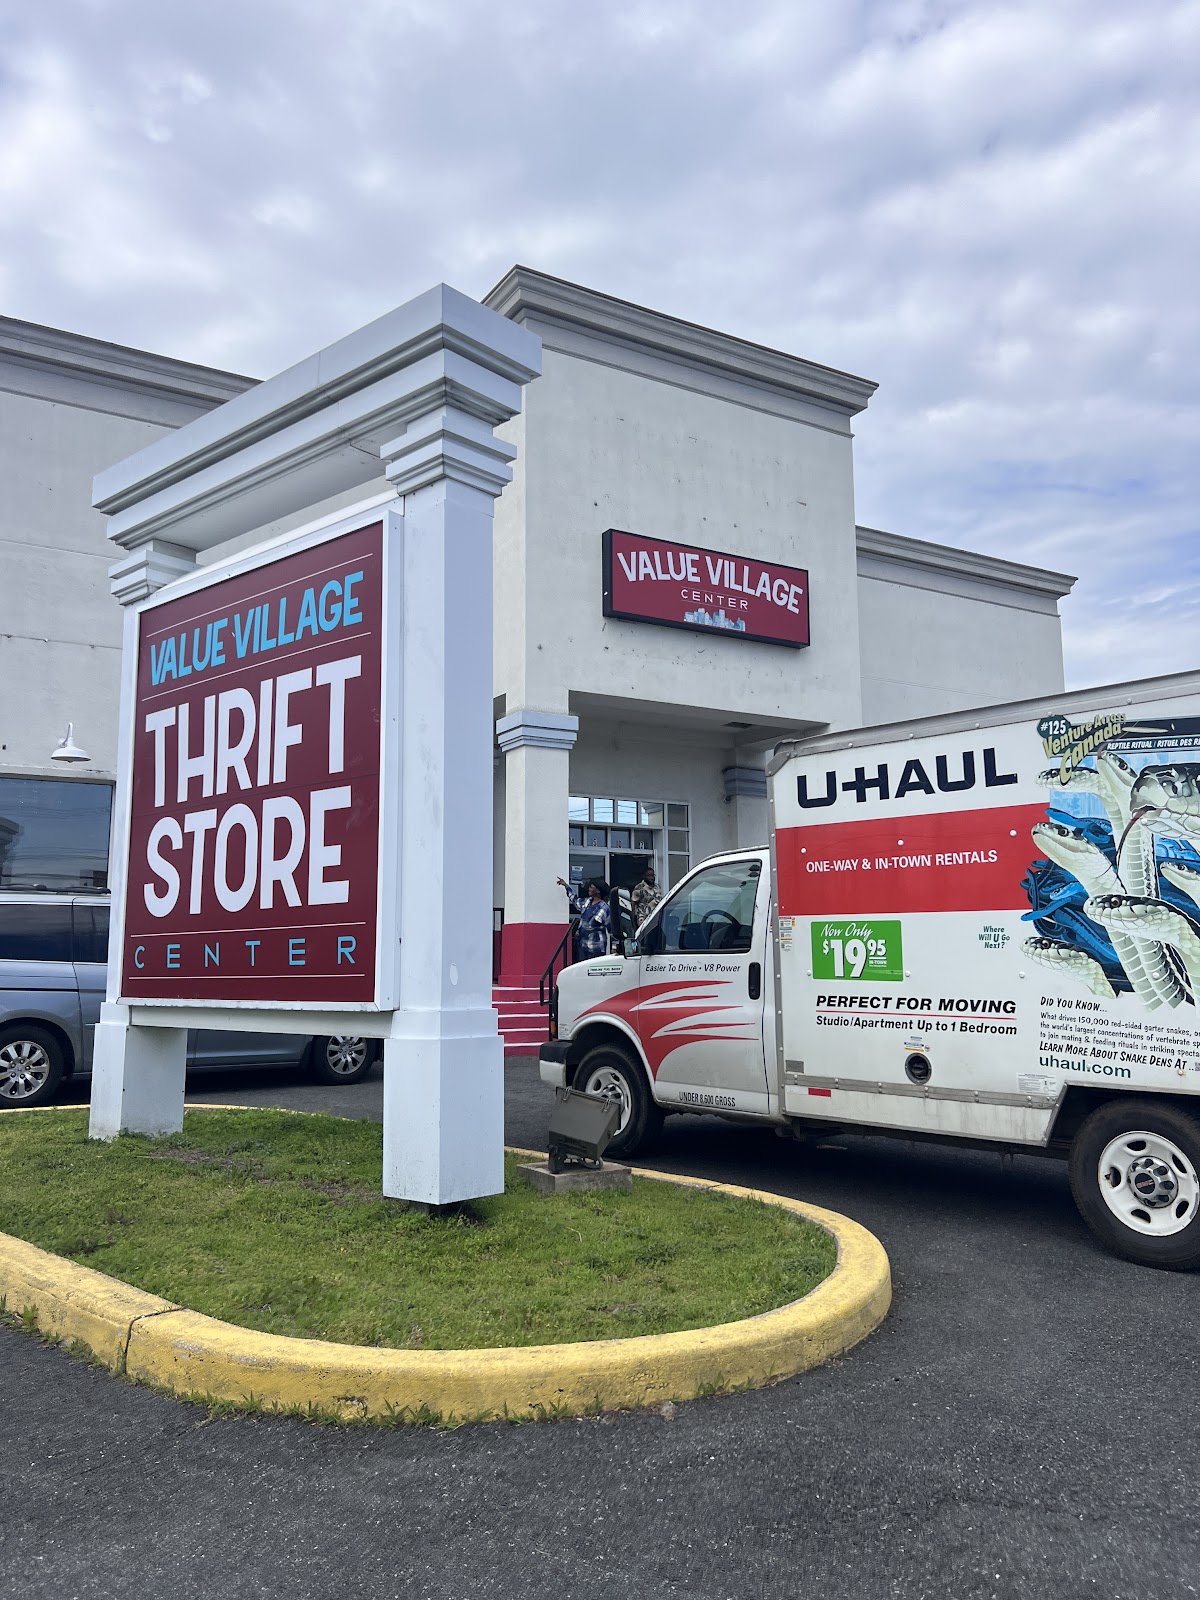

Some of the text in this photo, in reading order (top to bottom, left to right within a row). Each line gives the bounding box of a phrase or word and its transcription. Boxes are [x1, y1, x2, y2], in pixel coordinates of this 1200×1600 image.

[616, 550, 804, 614] VALUE VILLAGE
[680, 588, 749, 610] CENTER
[150, 570, 365, 686] VALUE VILLAGE
[145, 654, 362, 808] THRIFT
[1040, 719, 1066, 735] #125
[1043, 713, 1126, 759] Venture Across
[1060, 723, 1122, 786] Canada
[1107, 741, 1131, 750] REPTILE
[1131, 740, 1153, 749] RITUAL
[1157, 738, 1178, 748] RITUEL
[1180, 738, 1192, 746] DES
[796, 747, 1019, 809] U-HAUL
[143, 785, 352, 918] STORE
[806, 849, 998, 873] ONE-WAY & IN-TOWN RENTALS
[820, 922, 873, 942] Now Only
[978, 933, 1011, 943] Will U Go
[983, 925, 1005, 933] Where
[134, 935, 358, 969] CENTER
[645, 963, 741, 972] Easier To Drive V8 Power
[815, 995, 1017, 1014] PERFECT FOR MOVING
[1040, 996, 1054, 1006] DID
[1057, 997, 1073, 1008] YOU
[815, 1015, 1018, 1036] Studio/Apartment Up to 1 Bedroom
[1040, 1011, 1057, 1020] What
[1059, 1013, 1077, 1023] drives
[1078, 1016, 1109, 1026] 150,000
[1111, 1020, 1142, 1030] red-sided
[1144, 1024, 1164, 1033] garter
[1166, 1026, 1192, 1037] snakes,
[1040, 1020, 1050, 1029] the
[1052, 1023, 1073, 1032] world's
[1075, 1024, 1096, 1035] largest
[1098, 1029, 1144, 1040] concentrations
[1156, 1036, 1190, 1046] vertebrate
[1039, 1041, 1064, 1053] LEARN
[1065, 1043, 1089, 1056] MORE
[1090, 1047, 1118, 1060] ABOUT
[1120, 1051, 1148, 1064] SNAKE
[1150, 1055, 1173, 1068] DENS
[1048, 1032, 1060, 1040] join
[1061, 1034, 1082, 1043] mating
[1093, 1036, 1116, 1048] feeding
[1118, 1040, 1138, 1049] rituals
[1150, 1045, 1175, 1056] striking
[1039, 1055, 1131, 1078] uhaul.com
[679, 1091, 699, 1103] UNDER
[714, 1095, 736, 1107] GROSS
